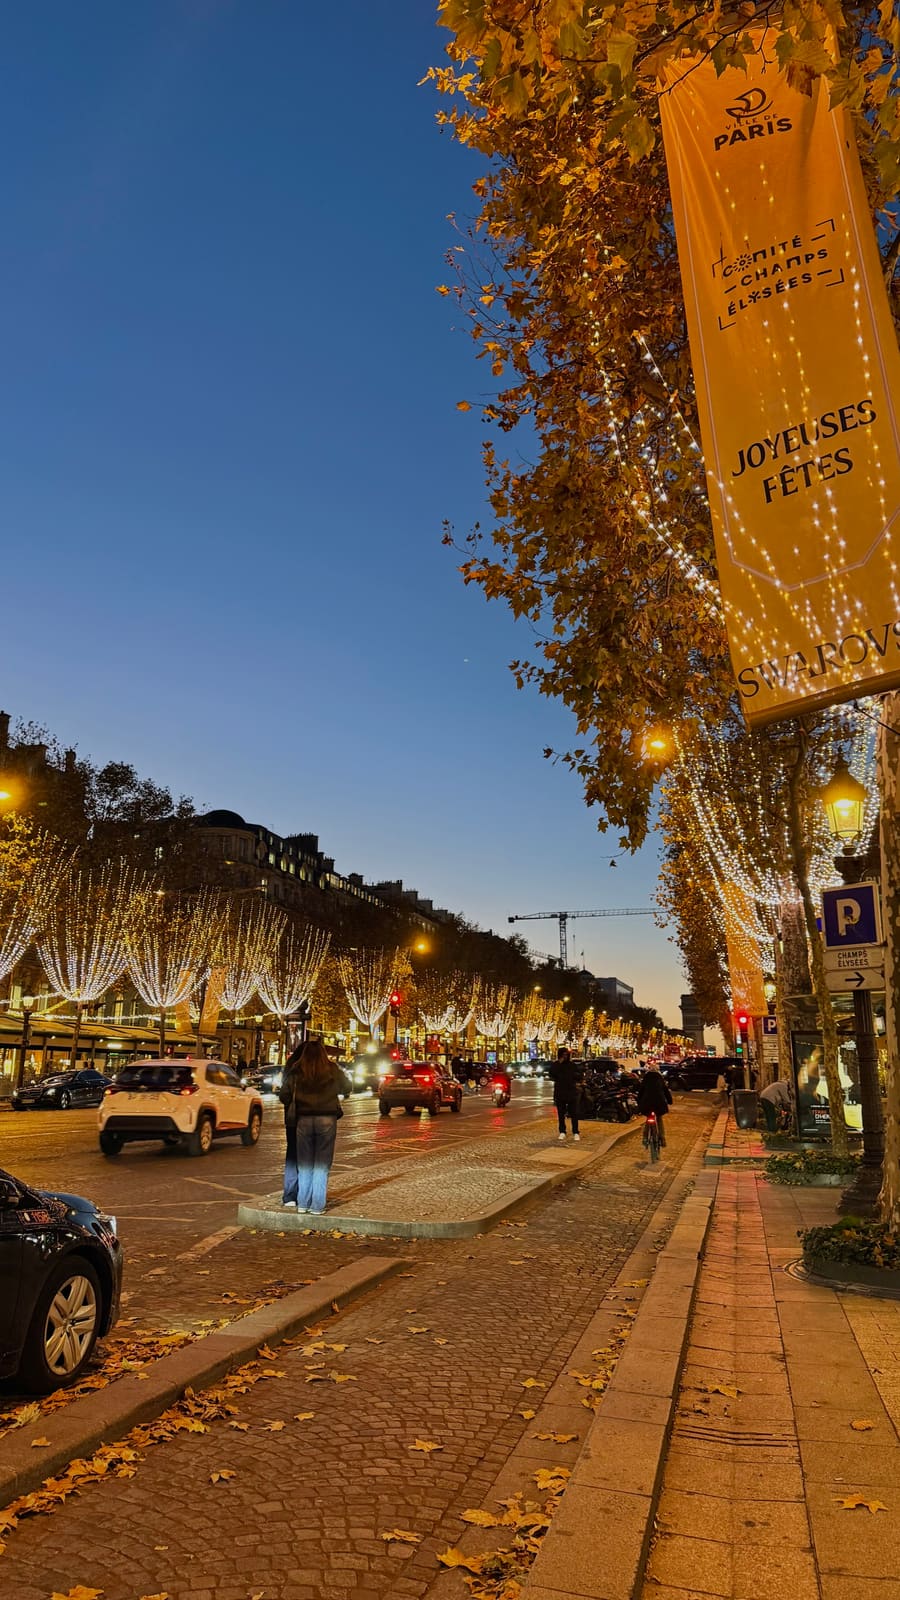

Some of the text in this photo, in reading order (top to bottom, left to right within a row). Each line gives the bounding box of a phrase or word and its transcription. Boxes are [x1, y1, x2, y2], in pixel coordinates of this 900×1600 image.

[714, 118, 793, 151] PARIS
[725, 118, 758, 130] VILLE
[741, 249, 828, 287] CHAMPS
[727, 273, 812, 316] ÉLYSÉES
[732, 399, 877, 477] JOYEUSES
[762, 447, 854, 504] FÊTES
[836, 898, 861, 936] P
[837, 950, 868, 959] CHAMPS
[768, 1019, 776, 1032] P
